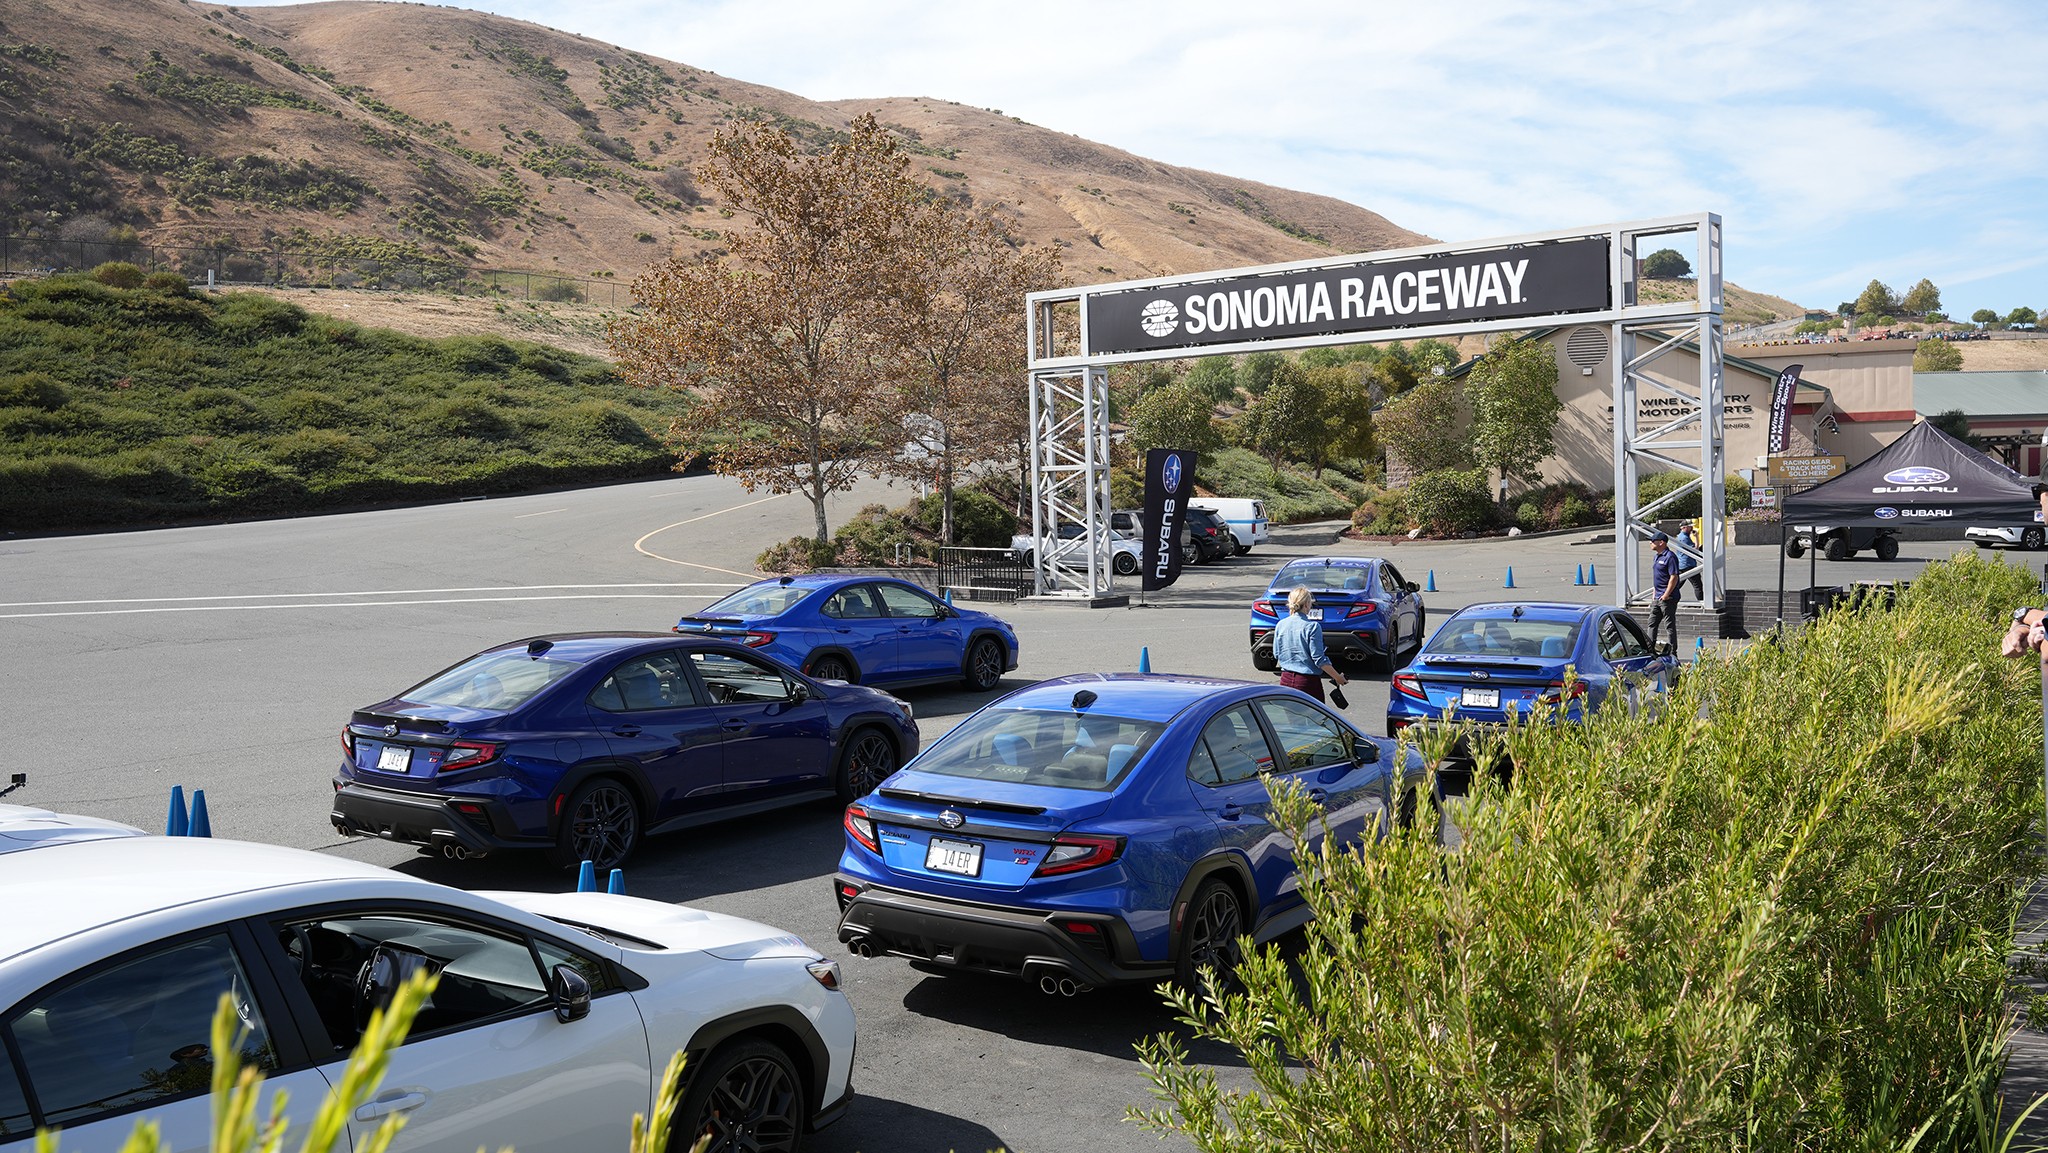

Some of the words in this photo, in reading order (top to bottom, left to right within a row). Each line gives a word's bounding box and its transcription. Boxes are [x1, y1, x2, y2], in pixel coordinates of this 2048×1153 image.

[1184, 281, 1335, 334] SONOMA
[1774, 374, 1787, 410] Country
[1781, 374, 1793, 406] Sports
[1641, 397, 1678, 406] WINE
[1639, 408, 1690, 417] MOTOR
[1771, 412, 1779, 434] Wine
[1778, 406, 1786, 434] Motor
[1872, 486, 1958, 494] SUBARU
[1901, 509, 1953, 517] SUBARU
[1156, 499, 1175, 579] SUBARU
[942, 849, 955, 867] 14
[957, 852, 972, 869] ER
[1013, 848, 1037, 857] WRX
